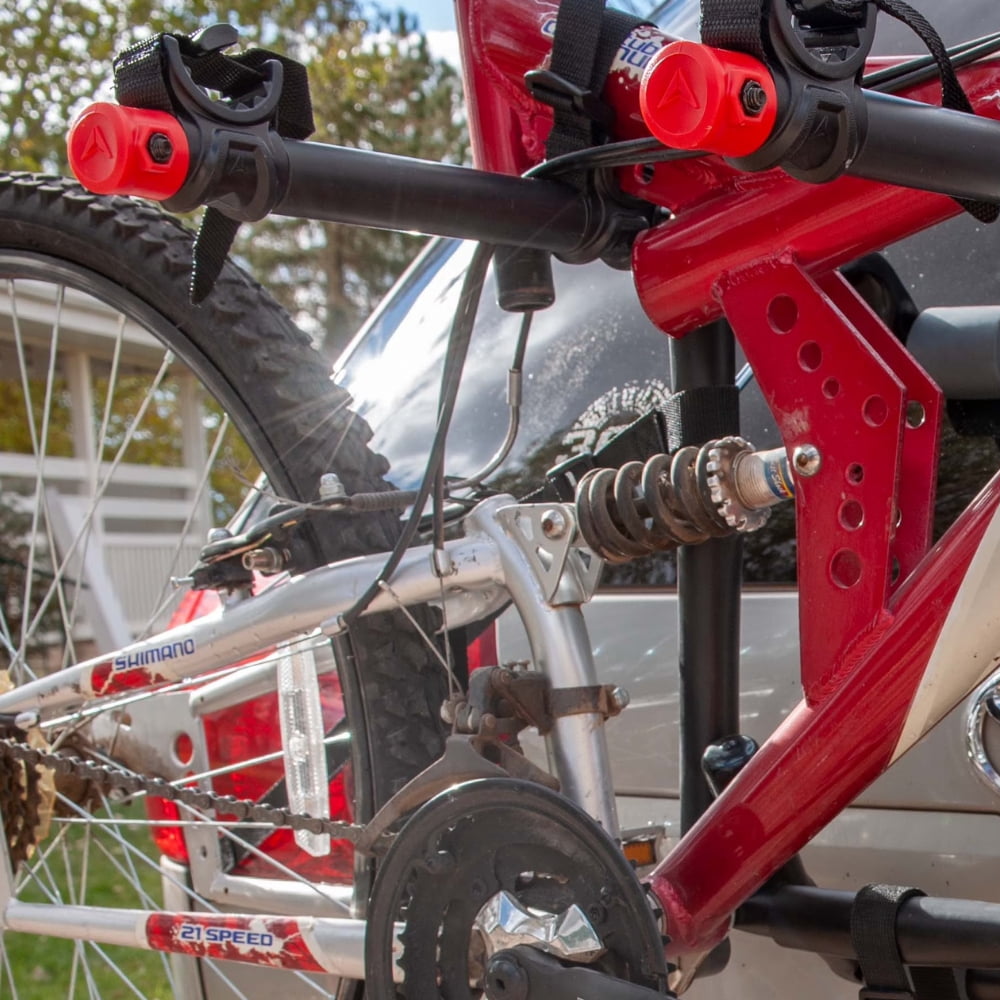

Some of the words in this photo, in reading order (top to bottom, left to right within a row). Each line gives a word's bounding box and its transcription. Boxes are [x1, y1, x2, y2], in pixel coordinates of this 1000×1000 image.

[114, 638, 196, 671] SHIMANO
[180, 925, 202, 940] 21
[205, 928, 273, 947] SPEED
